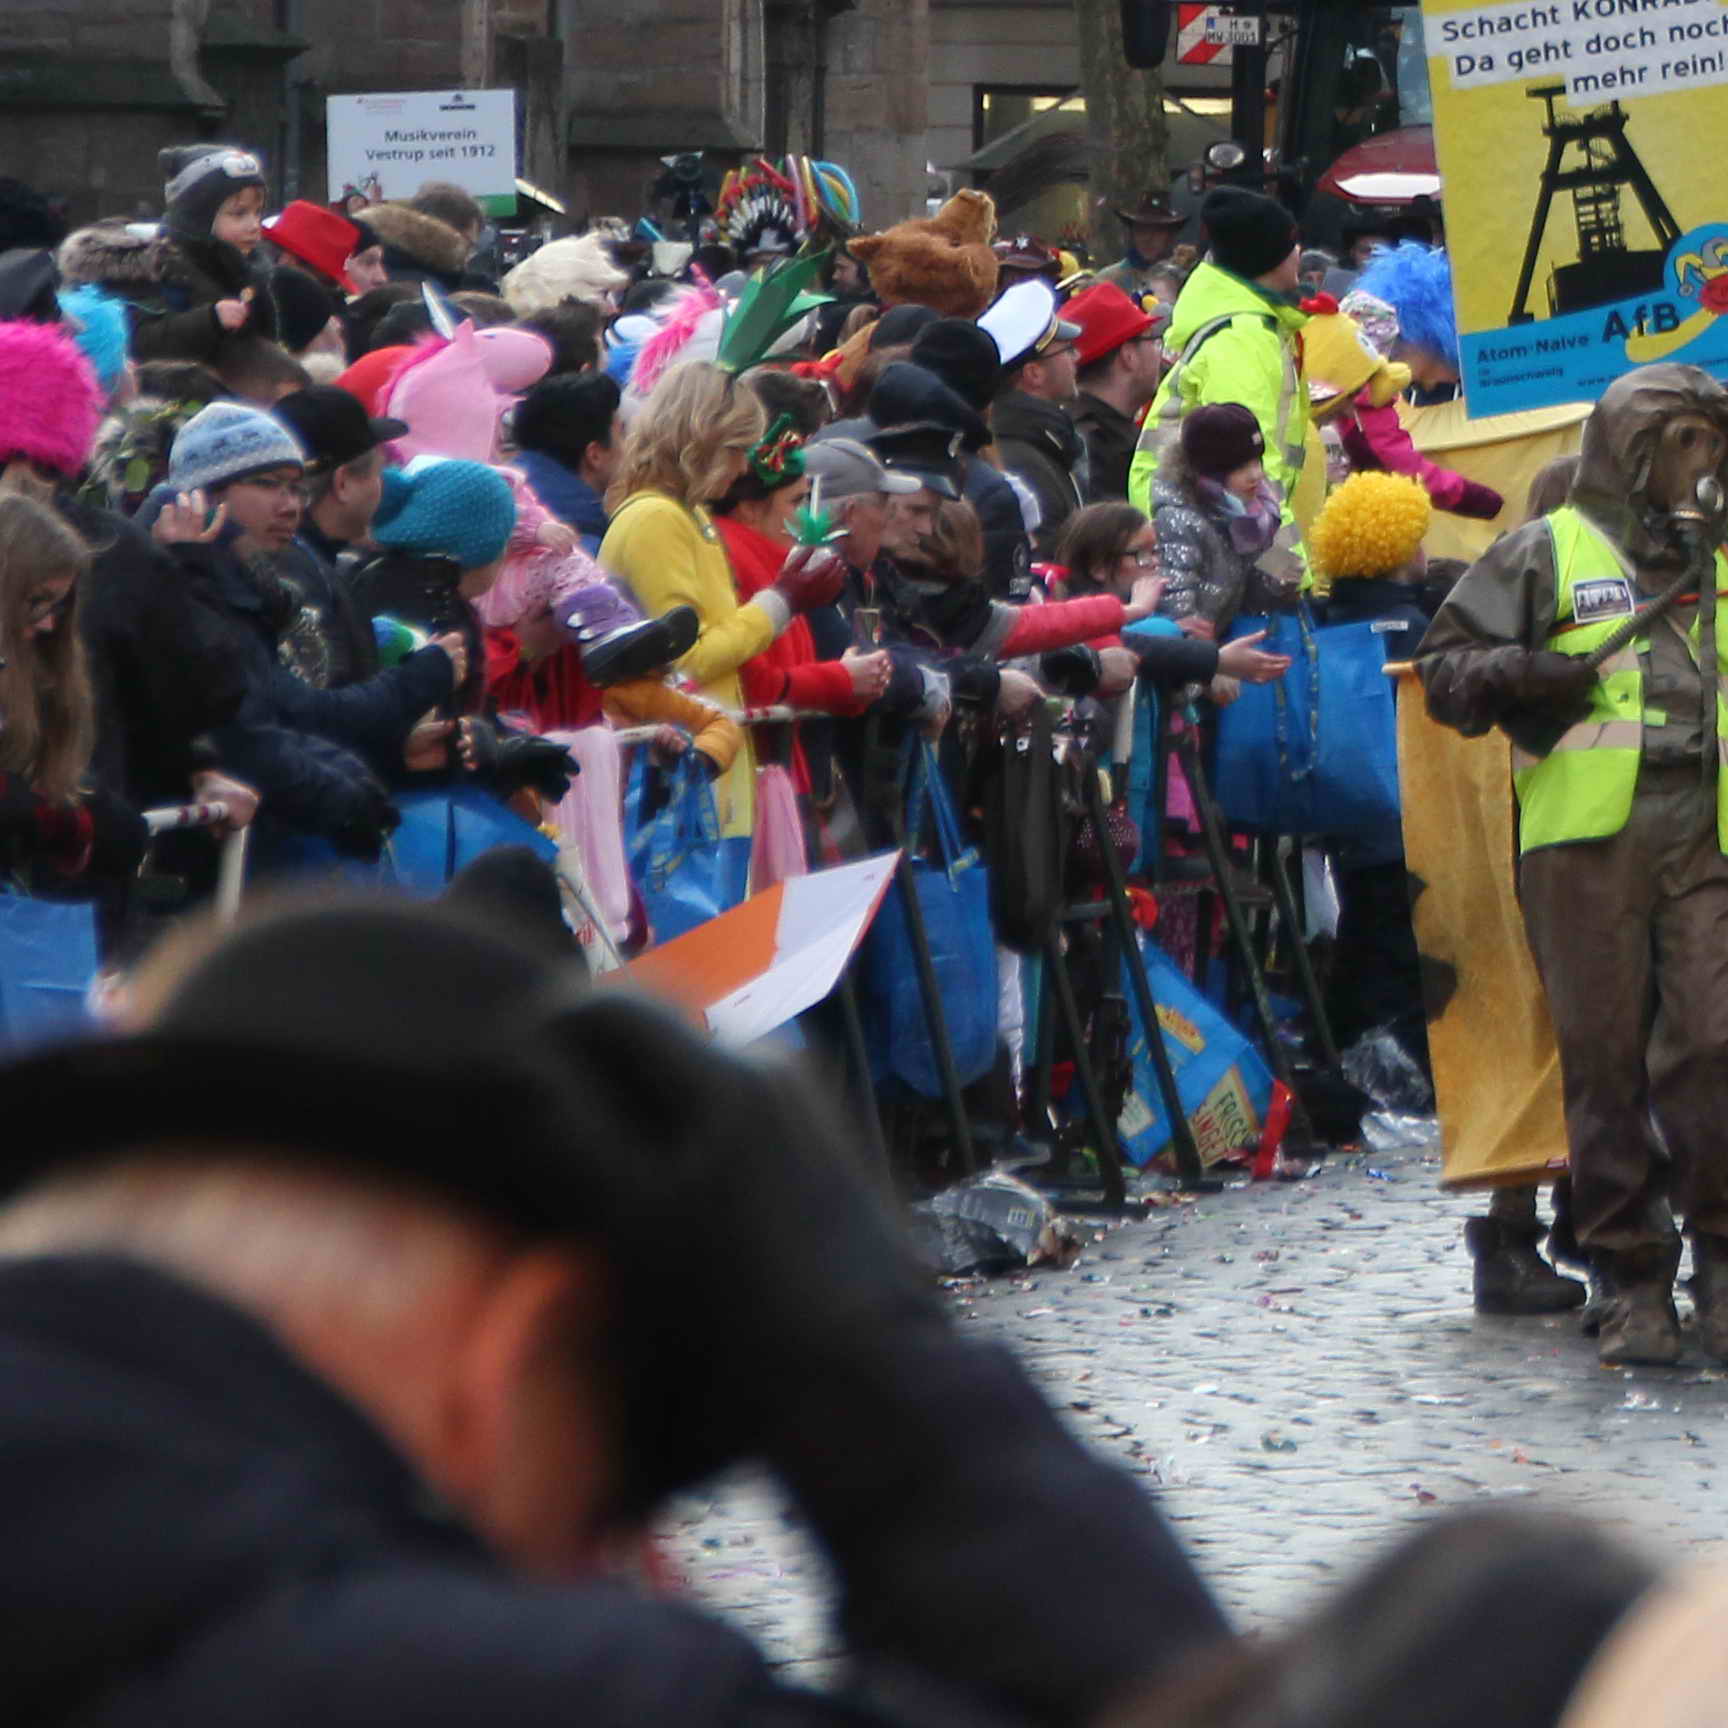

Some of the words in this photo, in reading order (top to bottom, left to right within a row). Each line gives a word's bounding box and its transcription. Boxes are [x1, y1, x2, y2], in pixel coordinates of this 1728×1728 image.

[1441, 4, 1560, 42] Schacht
[1456, 54, 1495, 76] Da
[1506, 41, 1573, 73] geht
[1585, 29, 1656, 55] doch
[1571, 66, 1649, 94] mehr
[1660, 52, 1726, 78] rein!
[384, 129, 477, 142] Musikverein
[429, 146, 455, 159] seit
[461, 145, 496, 158] 1912
[1600, 301, 1682, 345] AfB
[1476, 335, 1590, 363] Atom-Naive
